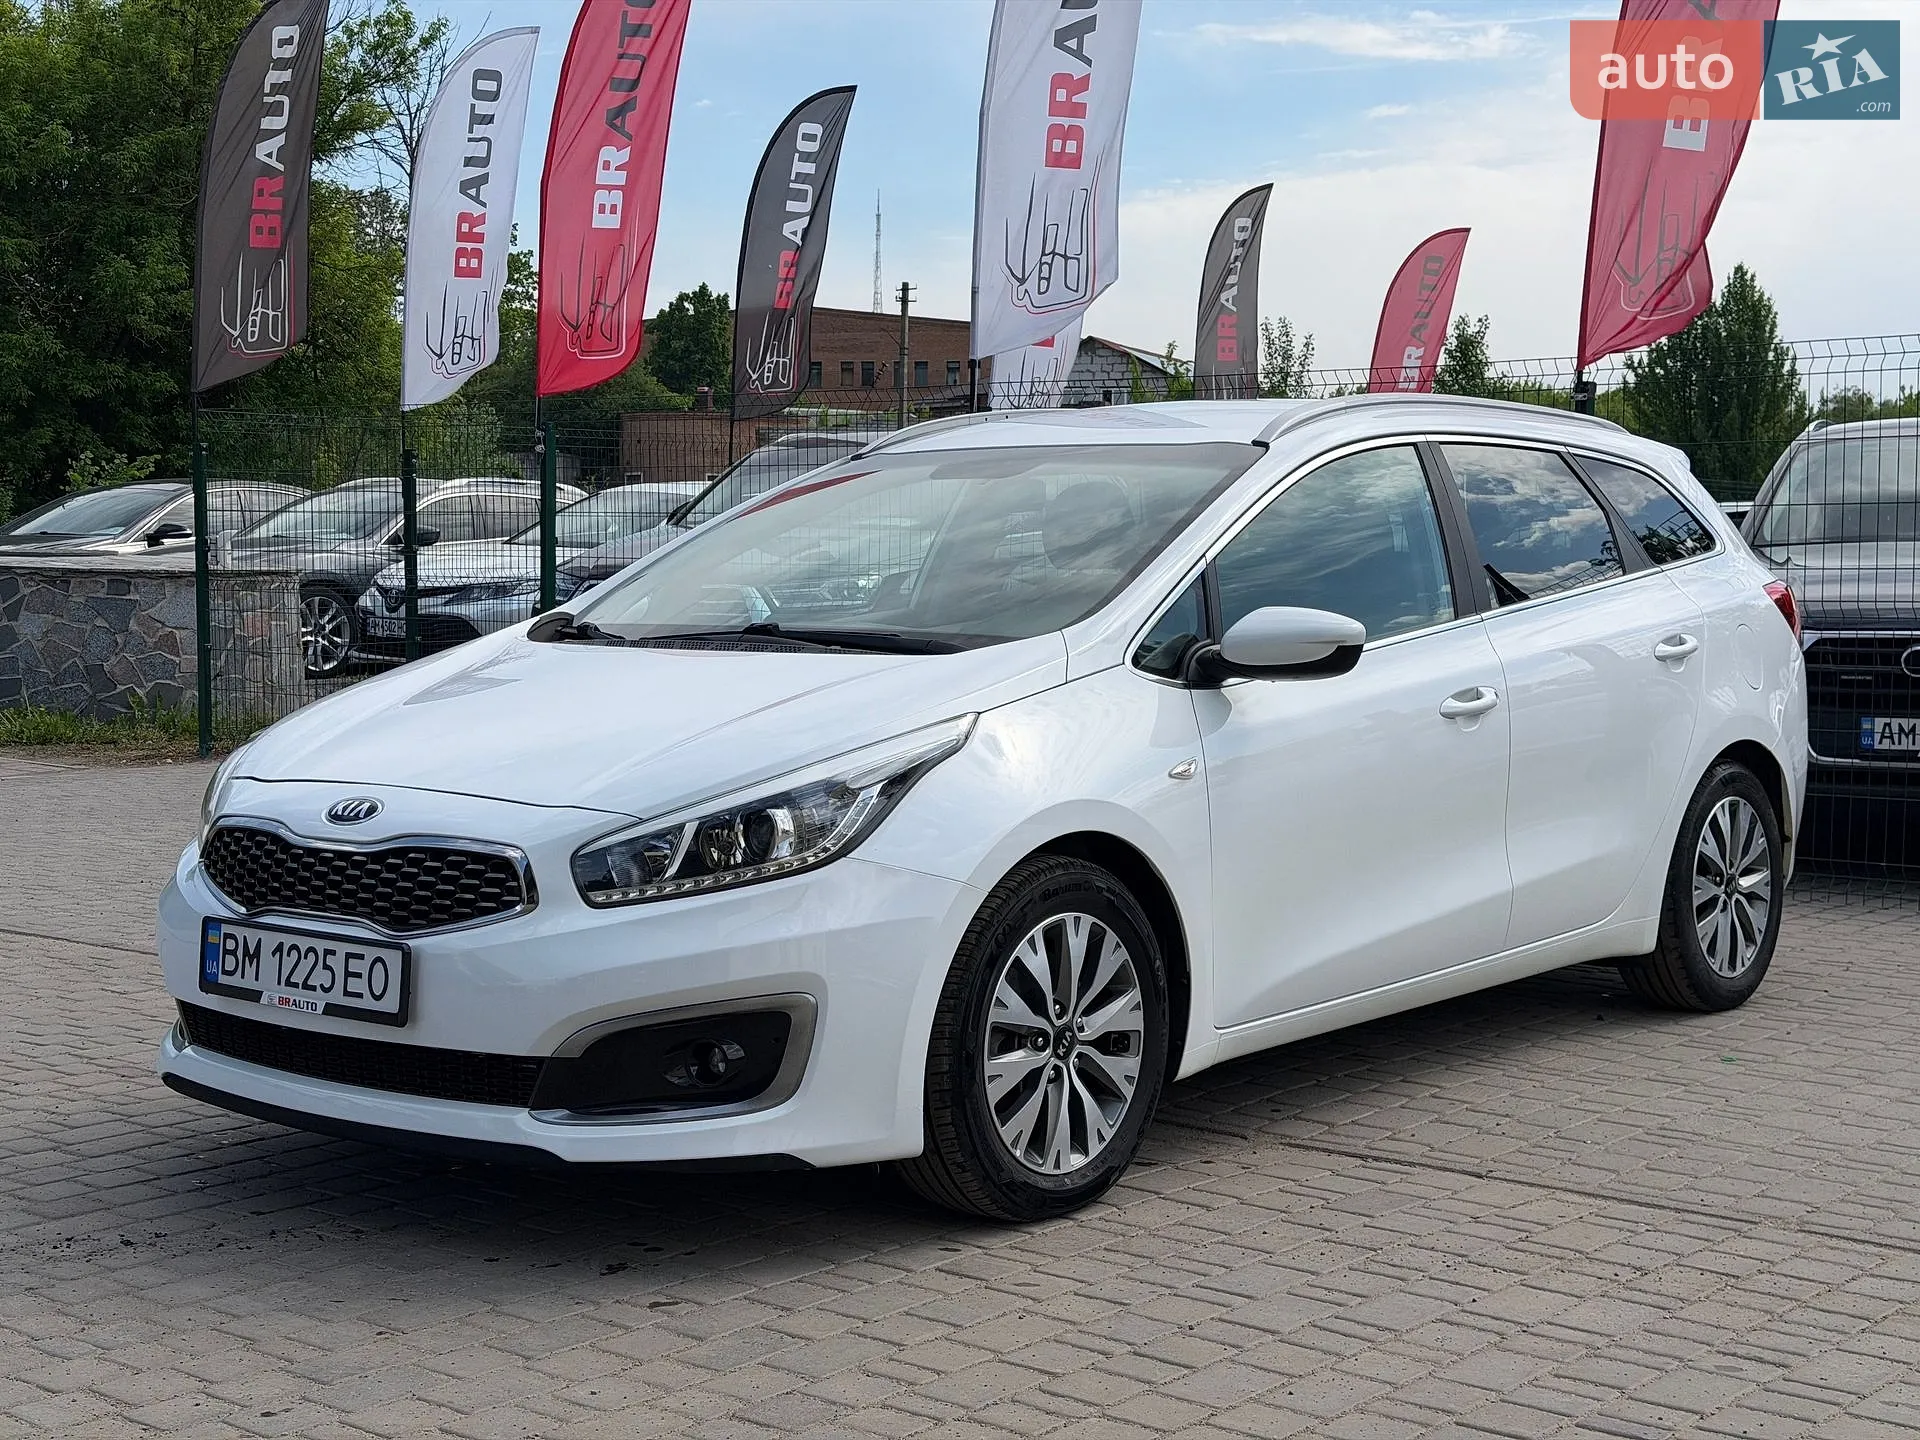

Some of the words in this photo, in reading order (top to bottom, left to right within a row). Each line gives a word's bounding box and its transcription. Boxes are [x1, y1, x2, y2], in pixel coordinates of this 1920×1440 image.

[249, 24, 300, 249] BRAUTO
[454, 68, 503, 279] BRAUTO
[591, 0, 657, 229] BRAUT
[774, 122, 823, 309] BRAUTO
[1216, 217, 1253, 362] BRAUTO
[1398, 255, 1445, 390] BRAUTO
[1878, 722, 1916, 746] AM
[330, 800, 372, 819] KIA
[206, 959, 218, 975] UA
[221, 932, 262, 982] BM
[271, 940, 337, 994] 1225
[343, 951, 389, 1001] EO
[278, 995, 318, 1012] BRAUTO
[1057, 1030, 1073, 1056] KIA
